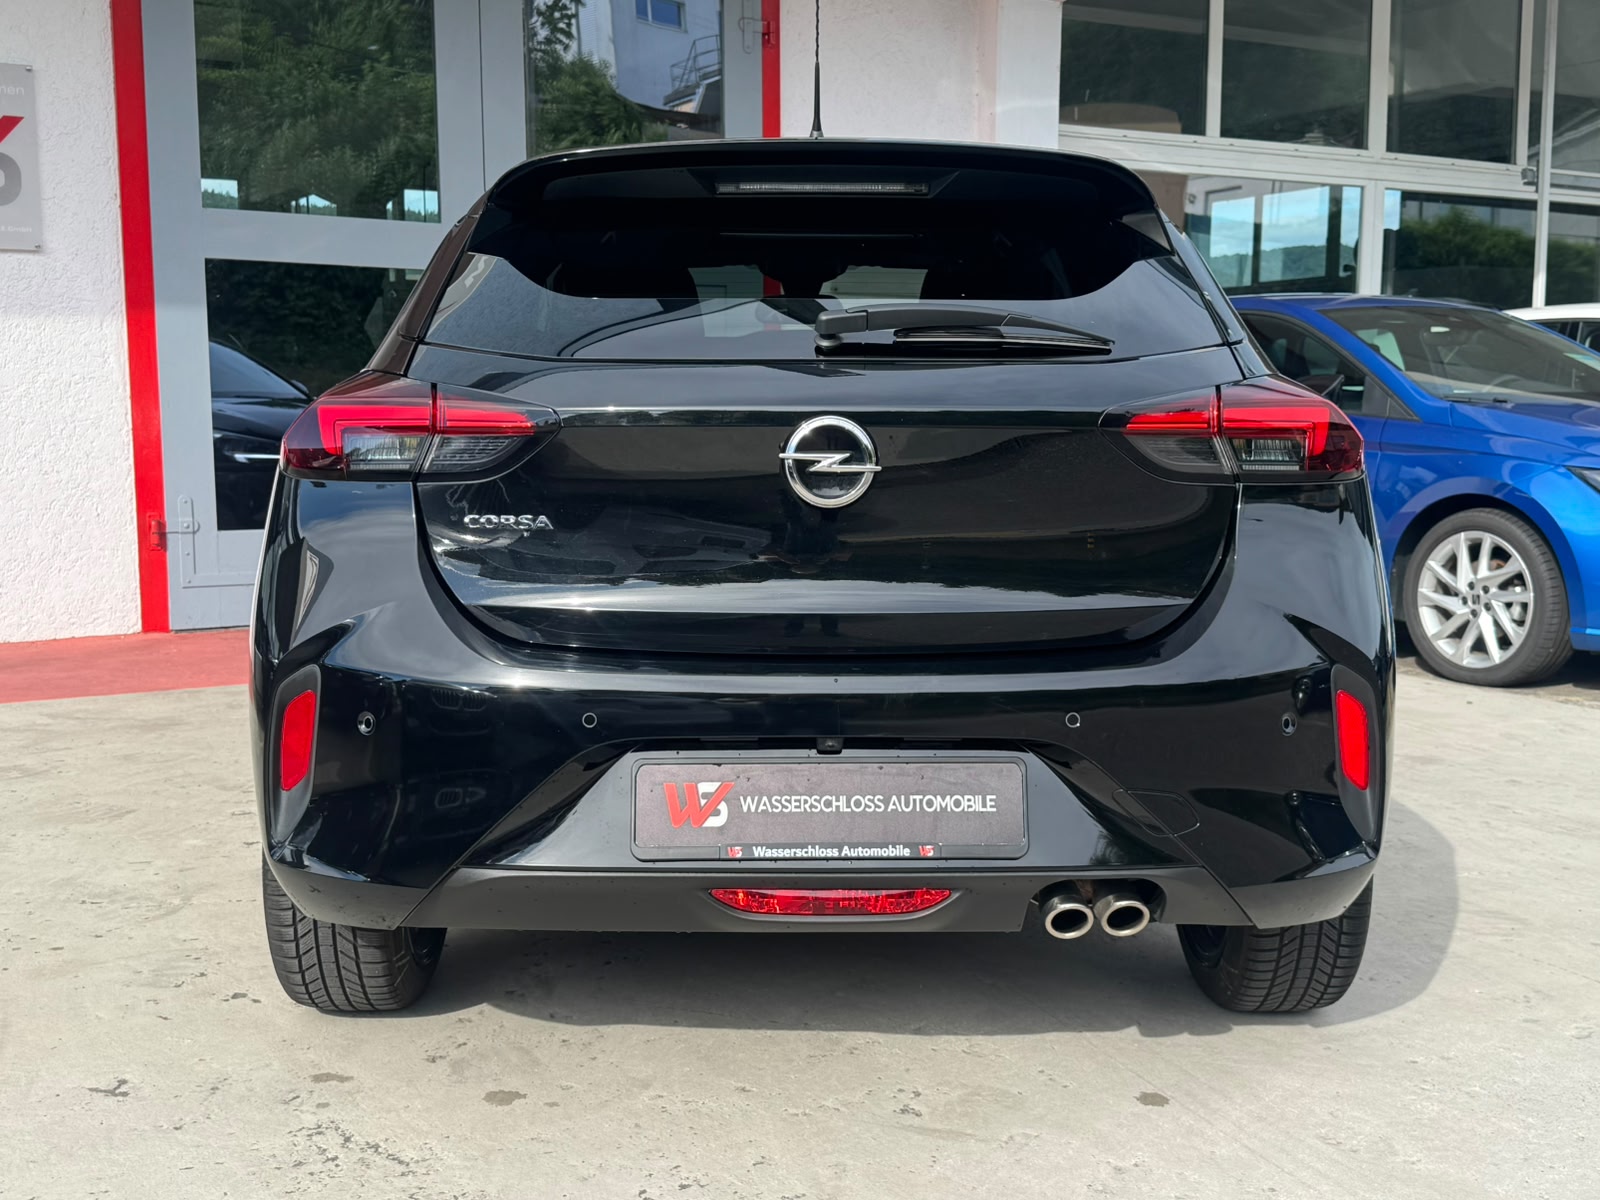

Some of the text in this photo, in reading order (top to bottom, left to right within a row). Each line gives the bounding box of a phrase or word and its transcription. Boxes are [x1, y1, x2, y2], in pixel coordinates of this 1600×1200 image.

[463, 514, 554, 530] CORSA
[739, 794, 997, 813] WASSERSCHLOSS AUTOMOBILE
[752, 845, 839, 857] Wasserschloss
[841, 844, 911, 857] Automobile
